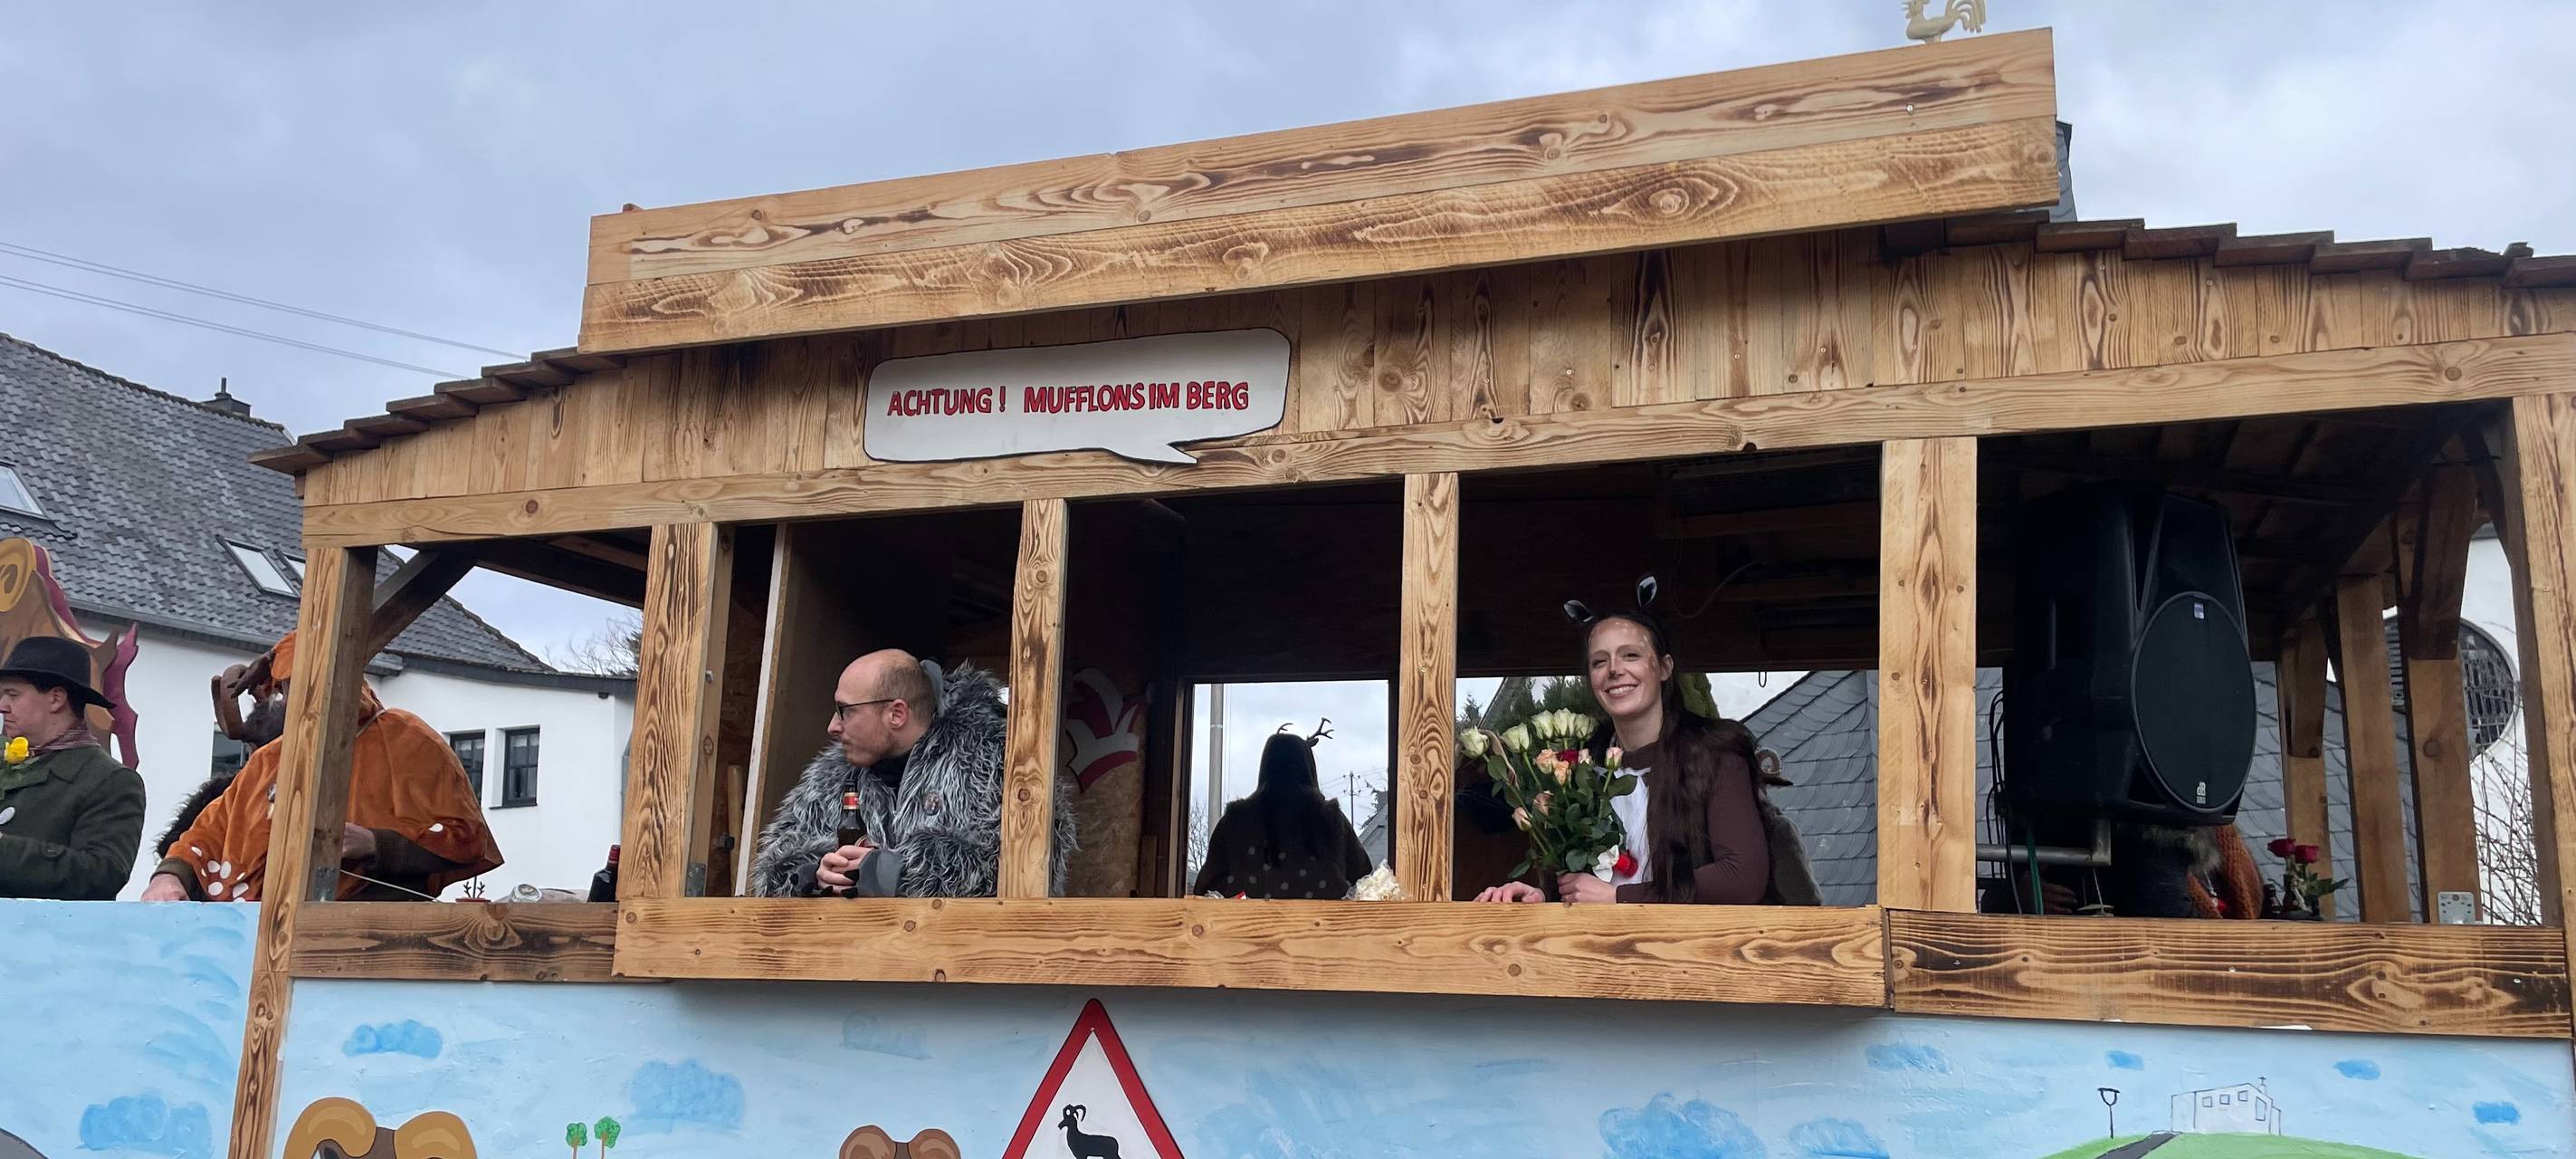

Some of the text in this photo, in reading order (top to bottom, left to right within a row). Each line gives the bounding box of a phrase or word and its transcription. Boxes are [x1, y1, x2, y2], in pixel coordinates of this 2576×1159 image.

[887, 388, 993, 417] ACHTUNG
[1024, 382, 1145, 414] MUFFLONS
[1149, 382, 1179, 409] IM
[1187, 381, 1248, 410] BERG
